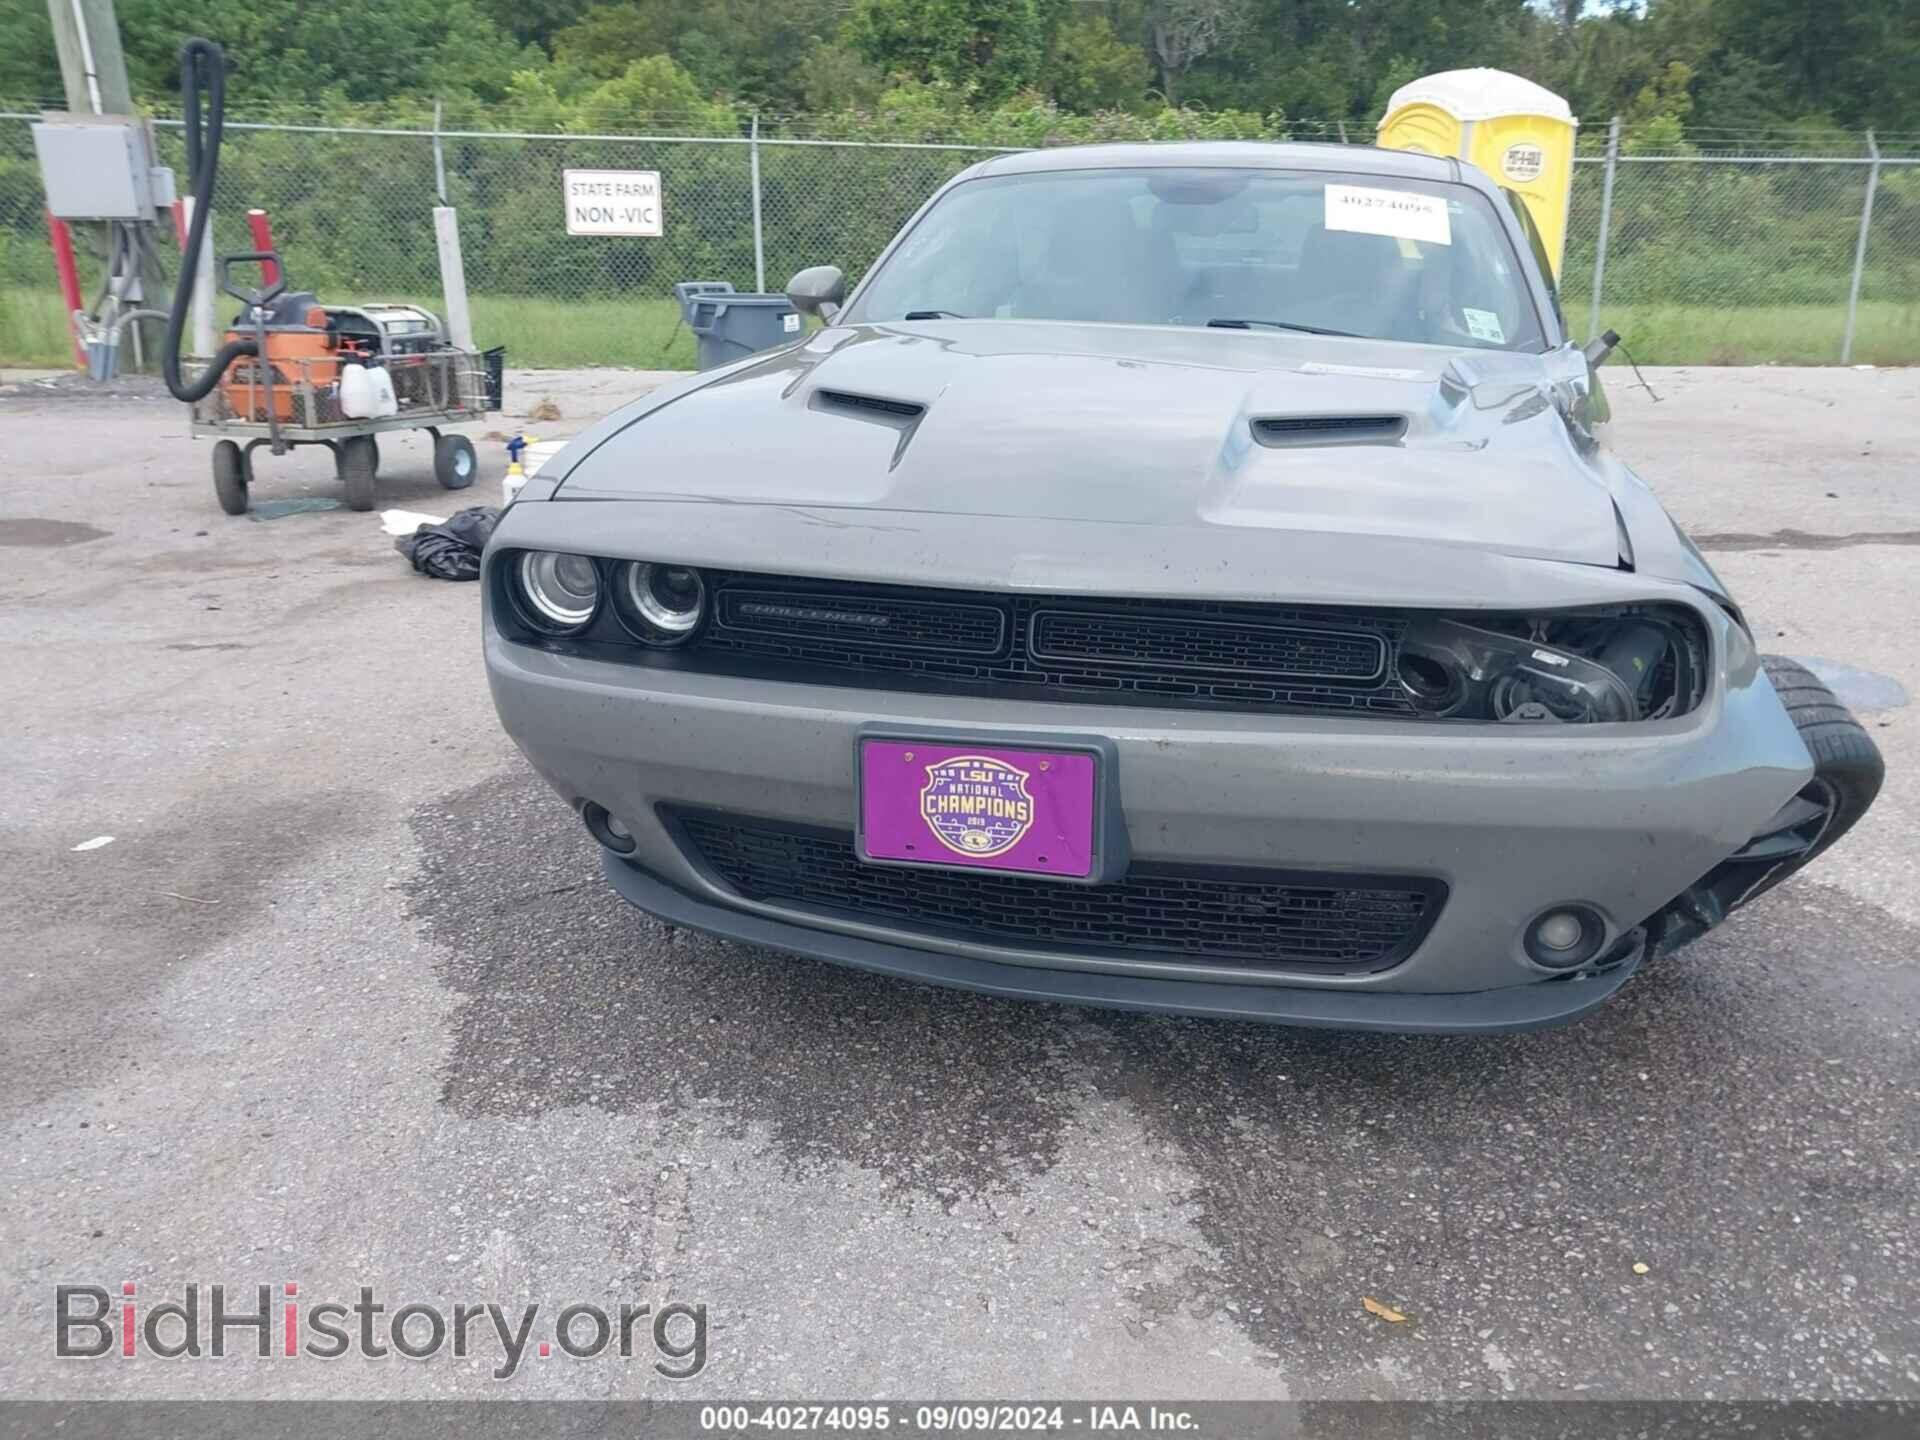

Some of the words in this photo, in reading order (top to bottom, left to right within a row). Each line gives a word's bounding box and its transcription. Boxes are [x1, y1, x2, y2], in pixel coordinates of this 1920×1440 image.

[571, 183, 612, 197] STATE
[615, 183, 654, 198] FARM
[960, 769, 993, 783] LSU
[949, 783, 1004, 798] NATIONAL
[926, 795, 1028, 822] CHAMPIONS
